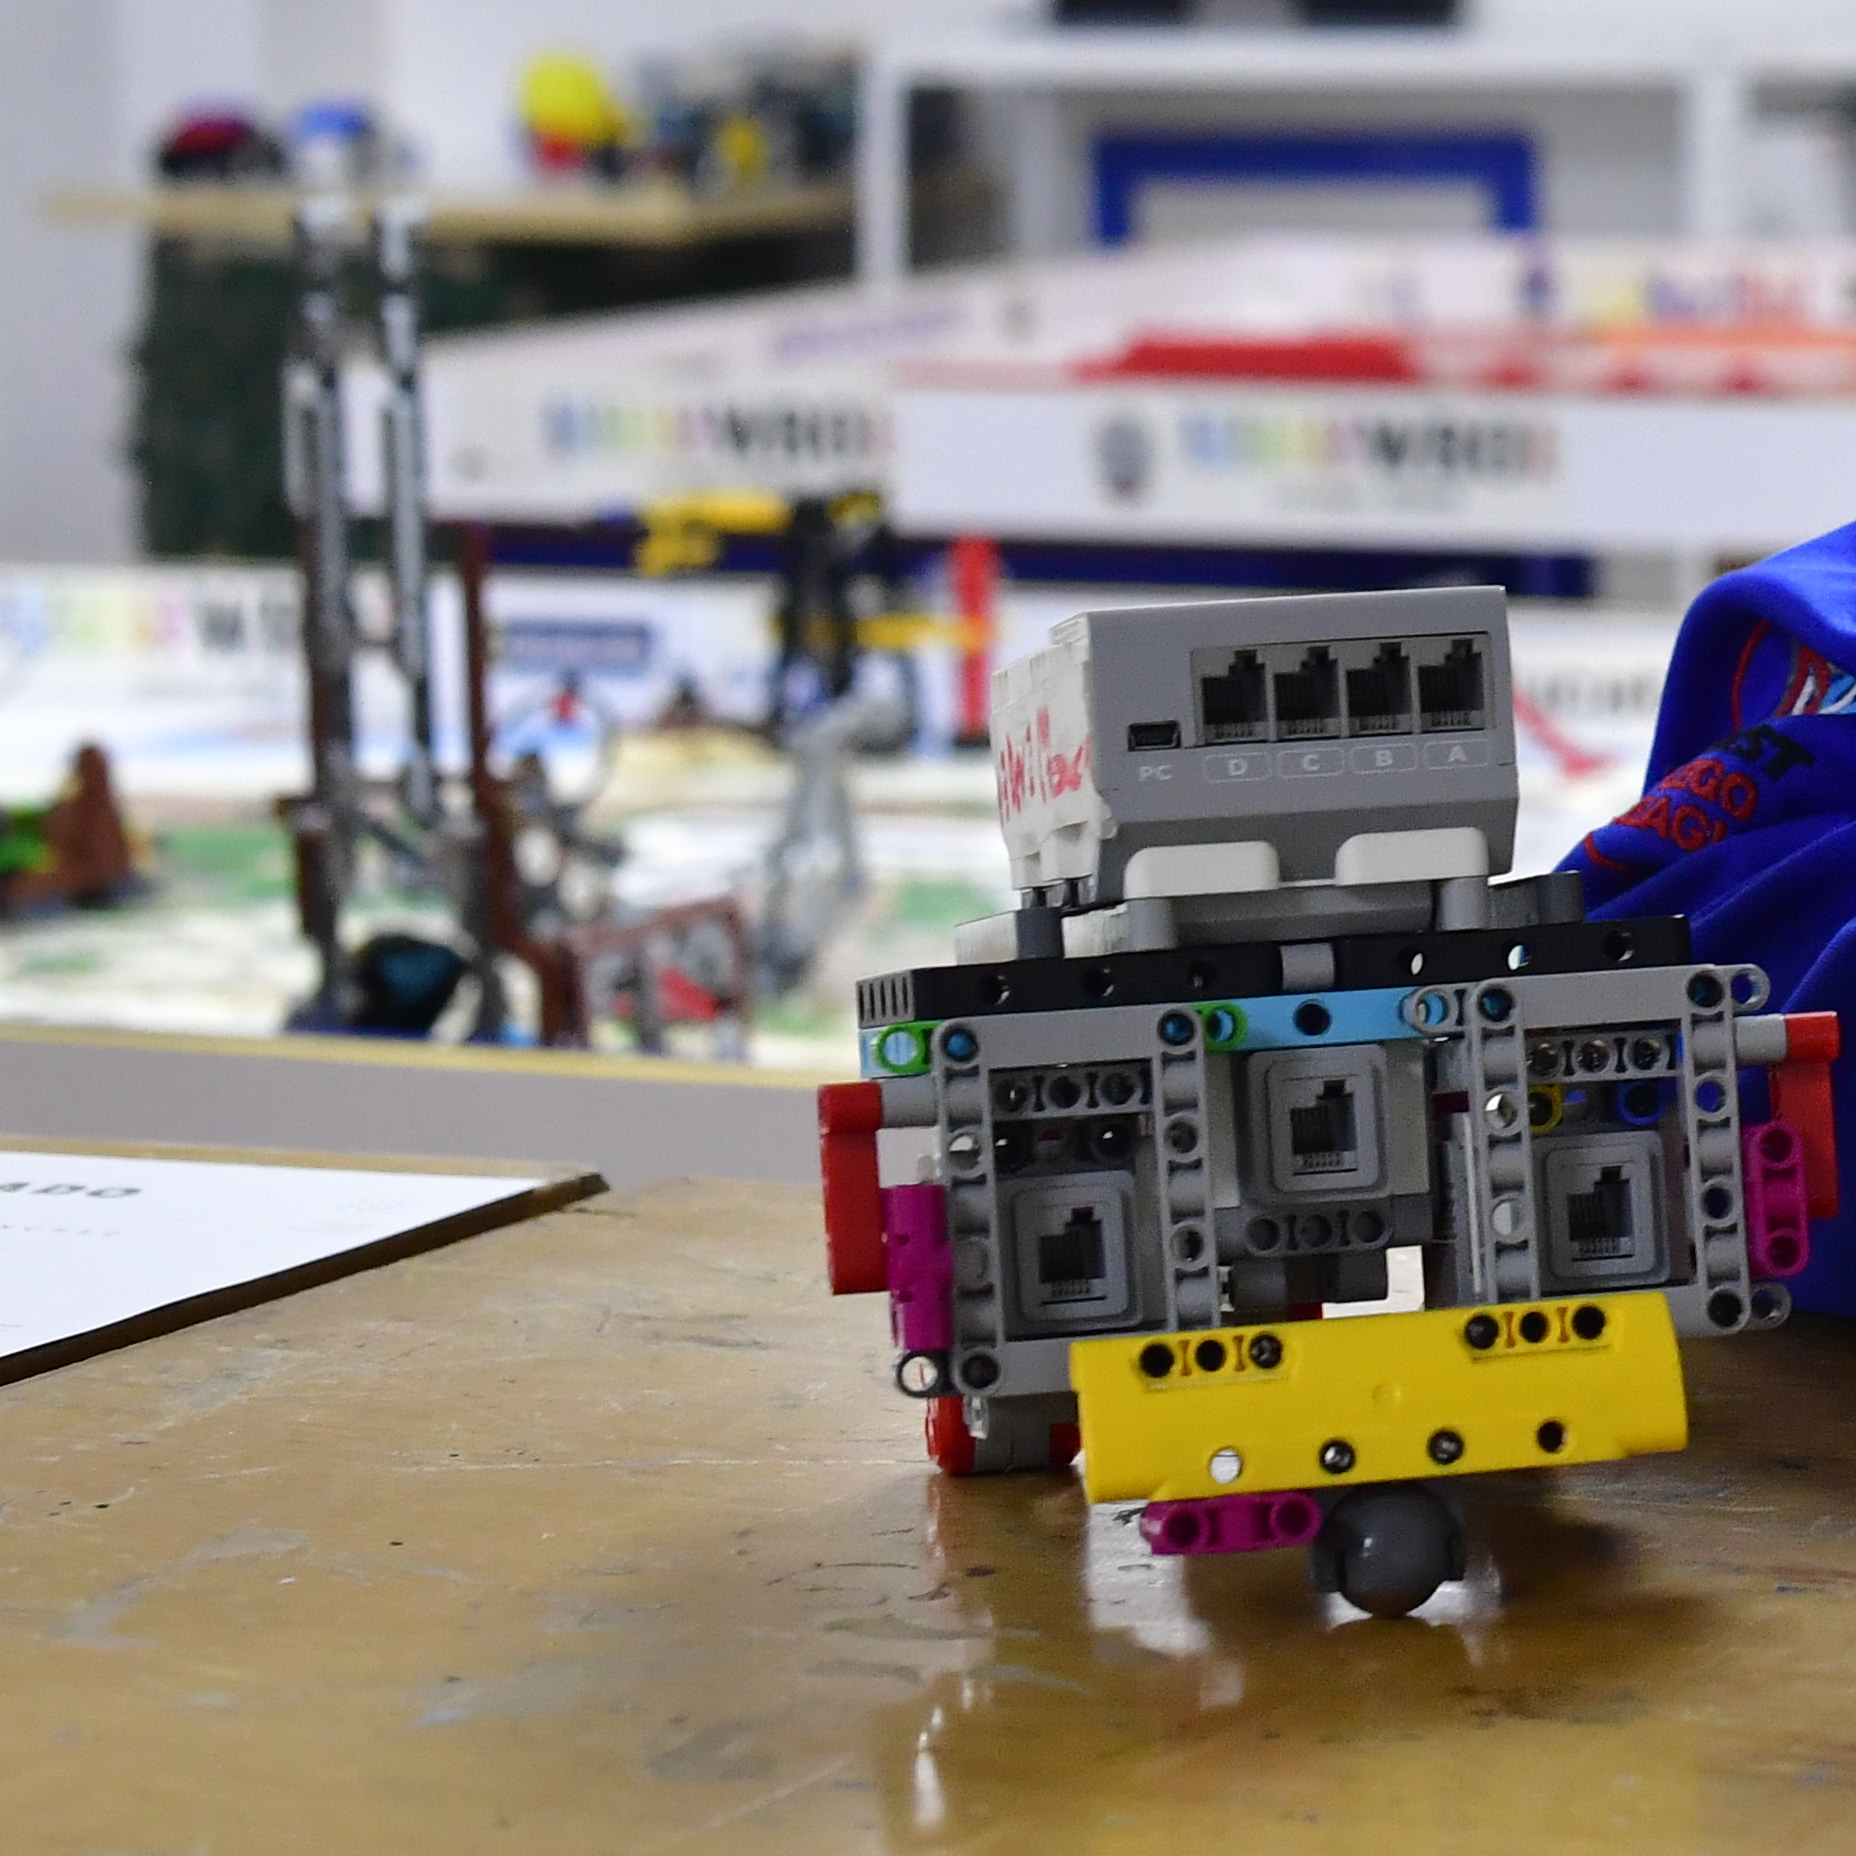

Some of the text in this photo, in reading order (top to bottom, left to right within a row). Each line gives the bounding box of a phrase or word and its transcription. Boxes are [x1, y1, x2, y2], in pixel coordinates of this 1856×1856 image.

[1138, 744, 1469, 782] PC D C B A
